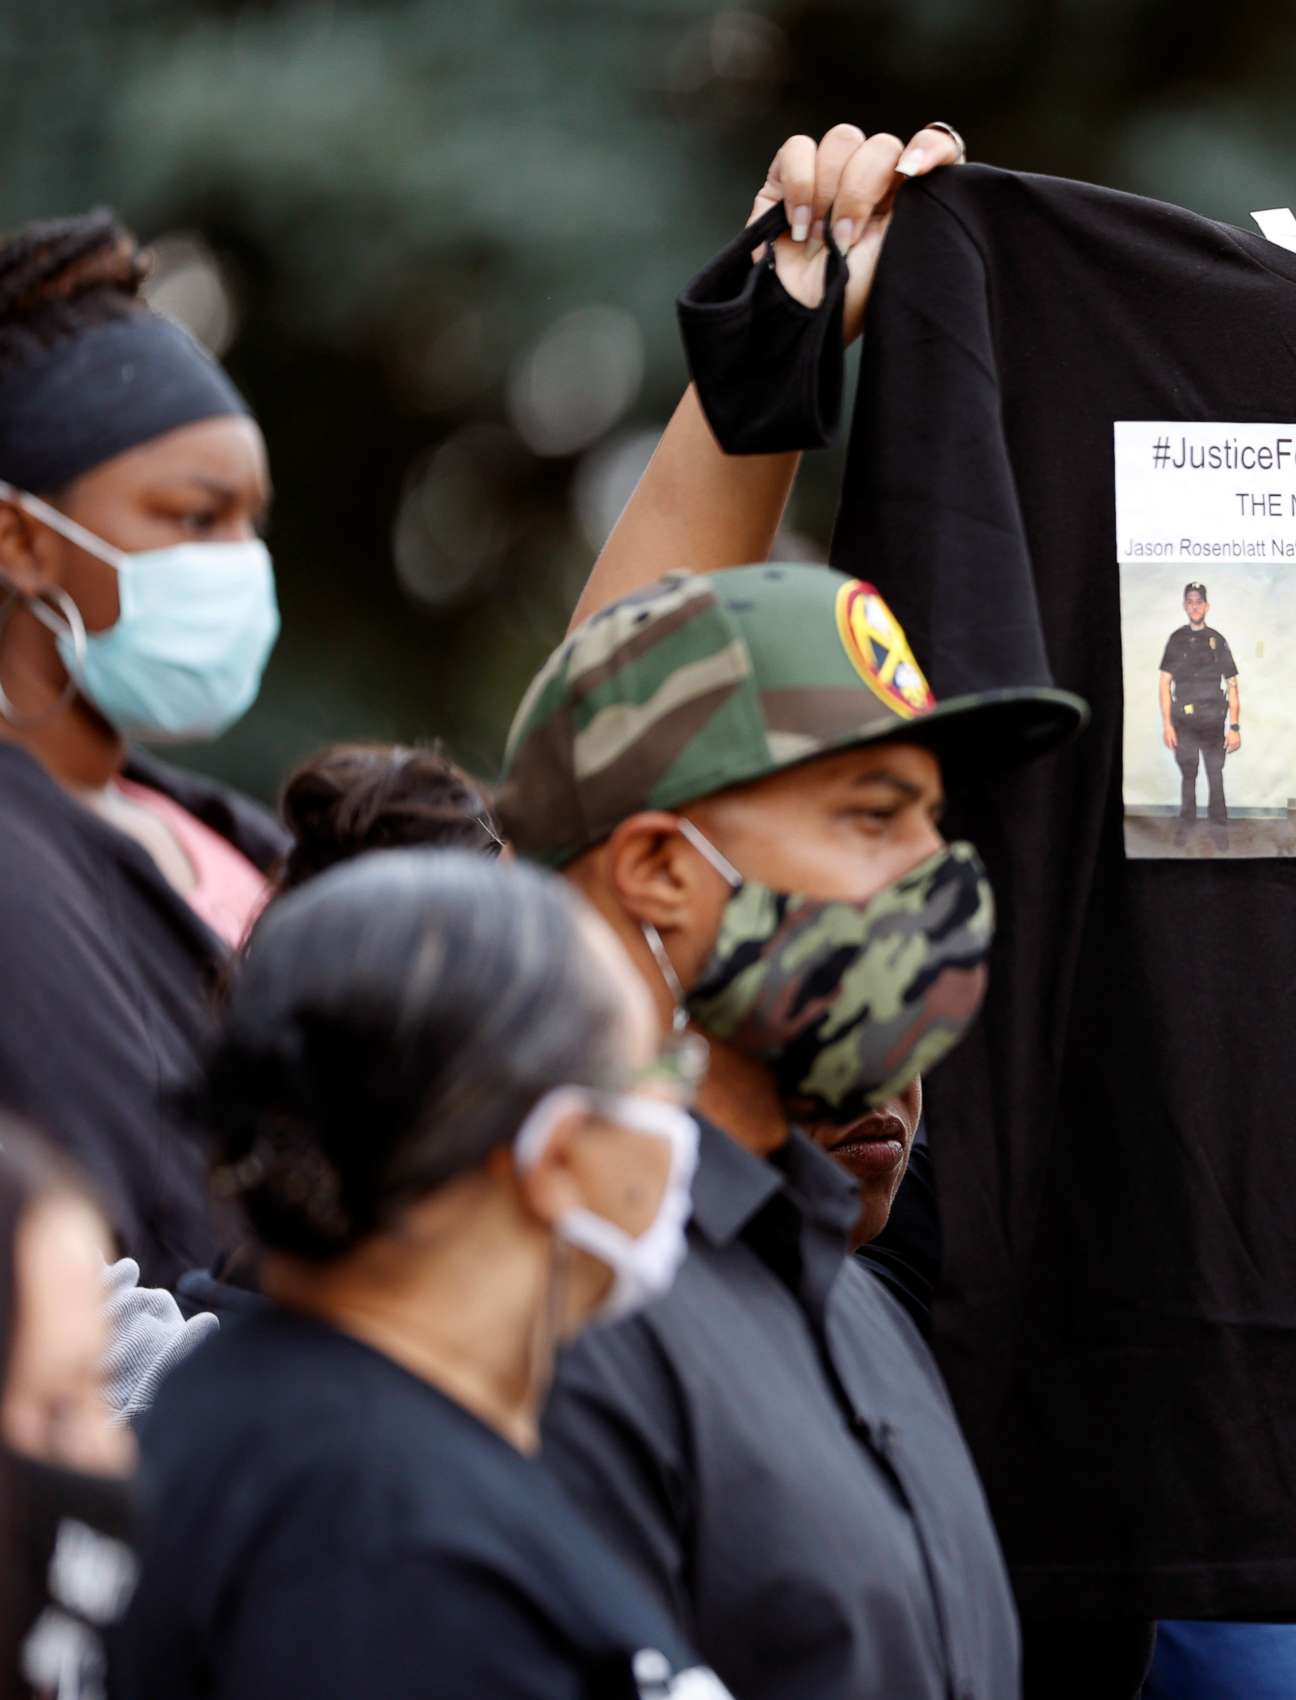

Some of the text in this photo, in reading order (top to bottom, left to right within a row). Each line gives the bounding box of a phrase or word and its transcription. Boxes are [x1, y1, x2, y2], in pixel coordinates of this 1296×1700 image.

[1235, 493, 1282, 518] THE
[1124, 538, 1173, 557] Jason
[1179, 538, 1266, 558] Rosenblatt
